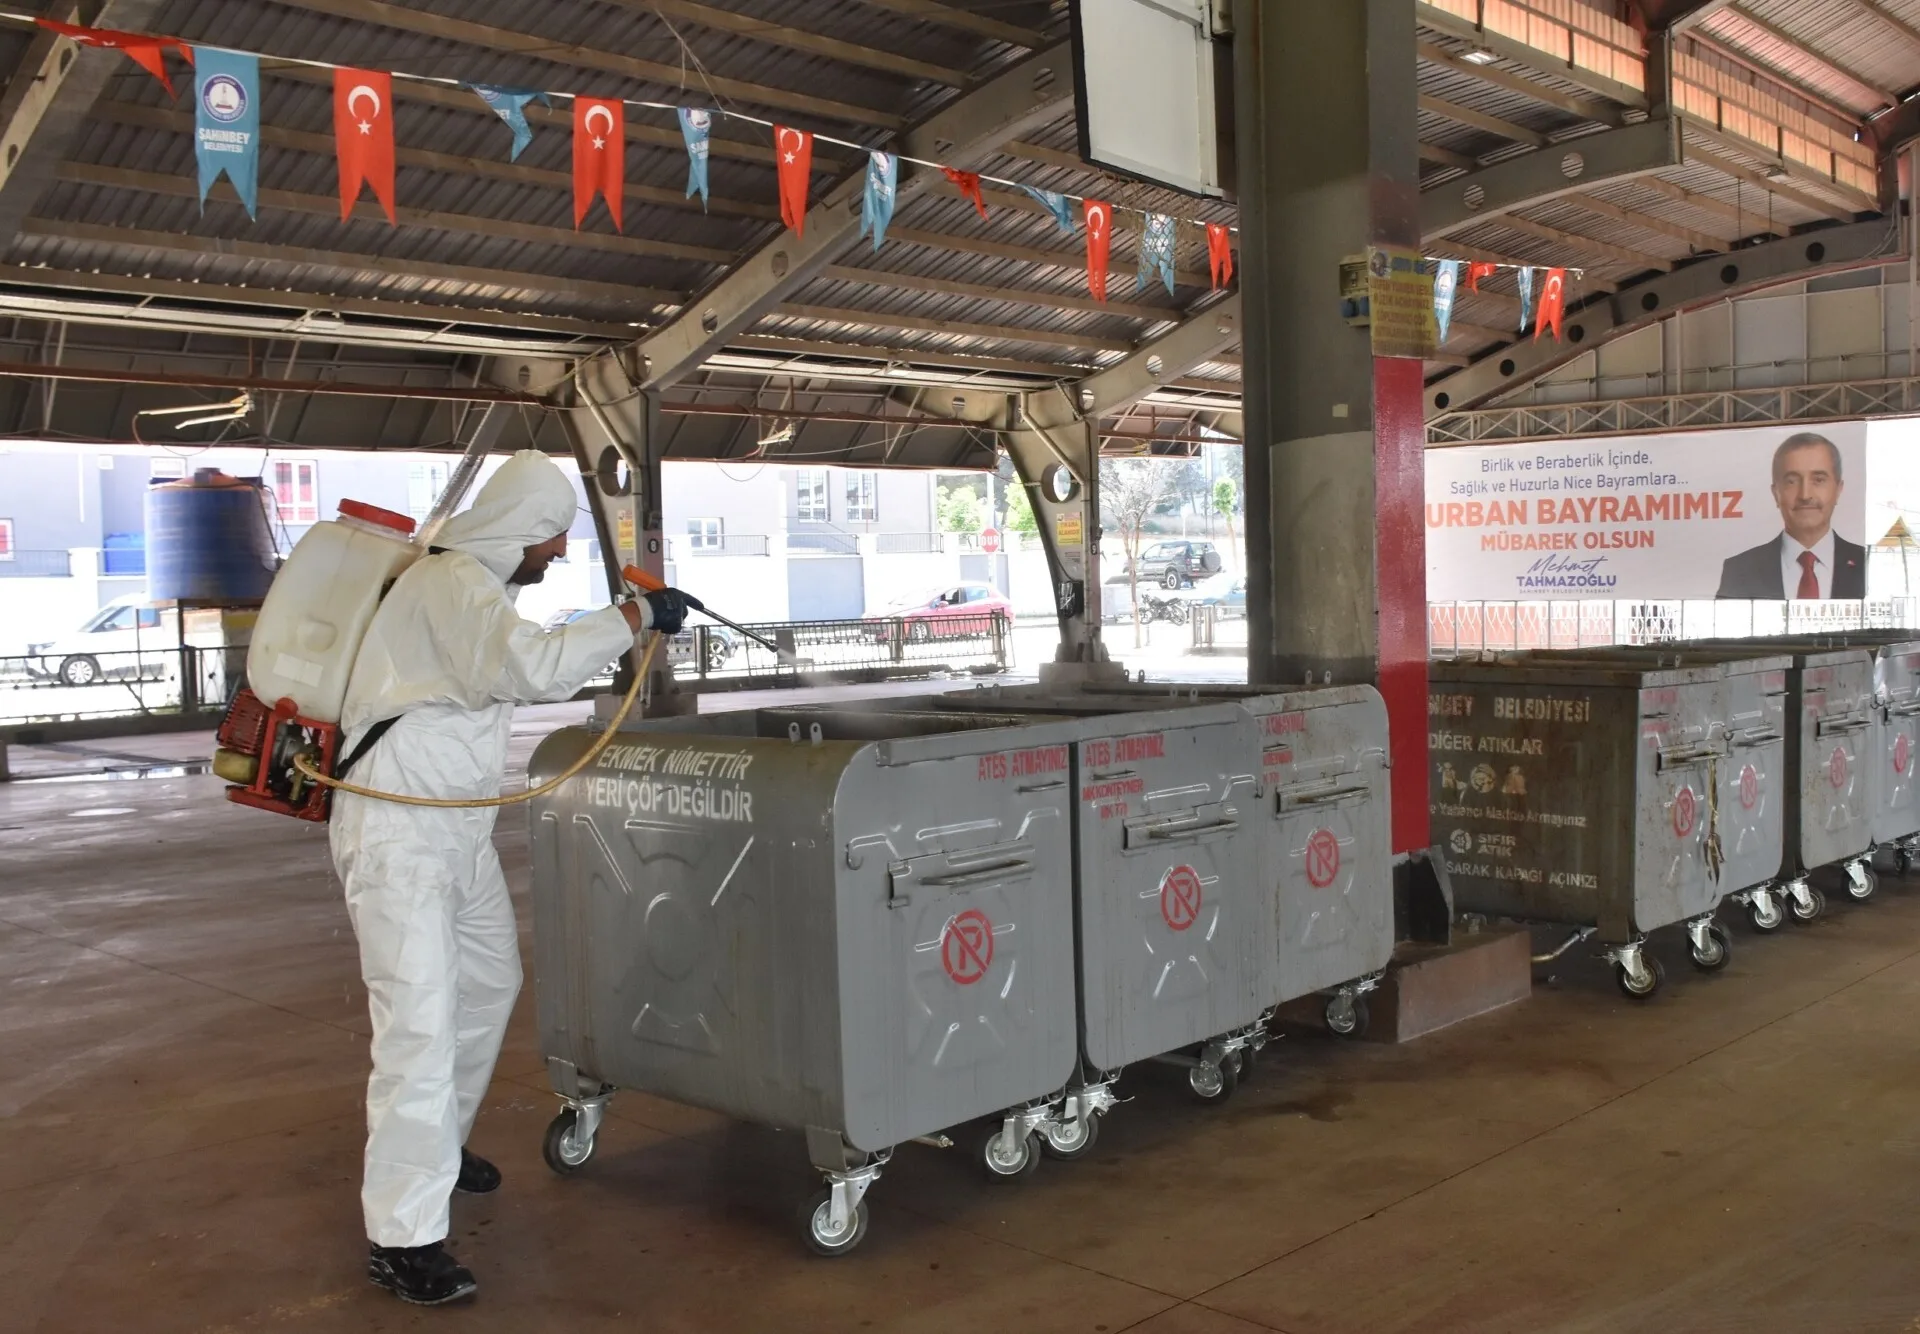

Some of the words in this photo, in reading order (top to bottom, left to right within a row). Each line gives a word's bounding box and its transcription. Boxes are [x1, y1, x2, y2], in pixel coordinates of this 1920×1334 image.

[1481, 458, 1514, 473] Birlik
[1518, 460, 1532, 471] ve
[1536, 453, 1604, 469] Beraberlik
[1451, 479, 1488, 497] Sağlık
[1492, 482, 1505, 493] ve
[1509, 477, 1559, 493] Huzurla
[1563, 474, 1593, 490] Nice
[1597, 472, 1689, 491] Bayramlara...
[1426, 499, 1528, 529] URBAN
[1537, 491, 1744, 526] BAYRAMIMIZ
[980, 535, 999, 547] DUR
[1481, 531, 1577, 552] MÜBAREK
[1583, 530, 1655, 550] OLSUN
[1526, 553, 1609, 576] Mehmet
[1516, 574, 1617, 588] TAHMAZOĞLU
[1493, 695, 1590, 723] BELEDİYESİ
[1428, 730, 1474, 751] DİĞER
[1477, 736, 1544, 756] ATIKLAR
[597, 744, 665, 774] EKMEK
[662, 746, 754, 781] NİMETTİR
[978, 753, 1006, 783] ATEŞ
[586, 773, 624, 809] YERİ
[627, 775, 663, 817] ÇÖP
[668, 779, 753, 823] DEĞİLDİR
[1477, 844, 1512, 857] ATIK
[1478, 833, 1516, 846] SIFIR
